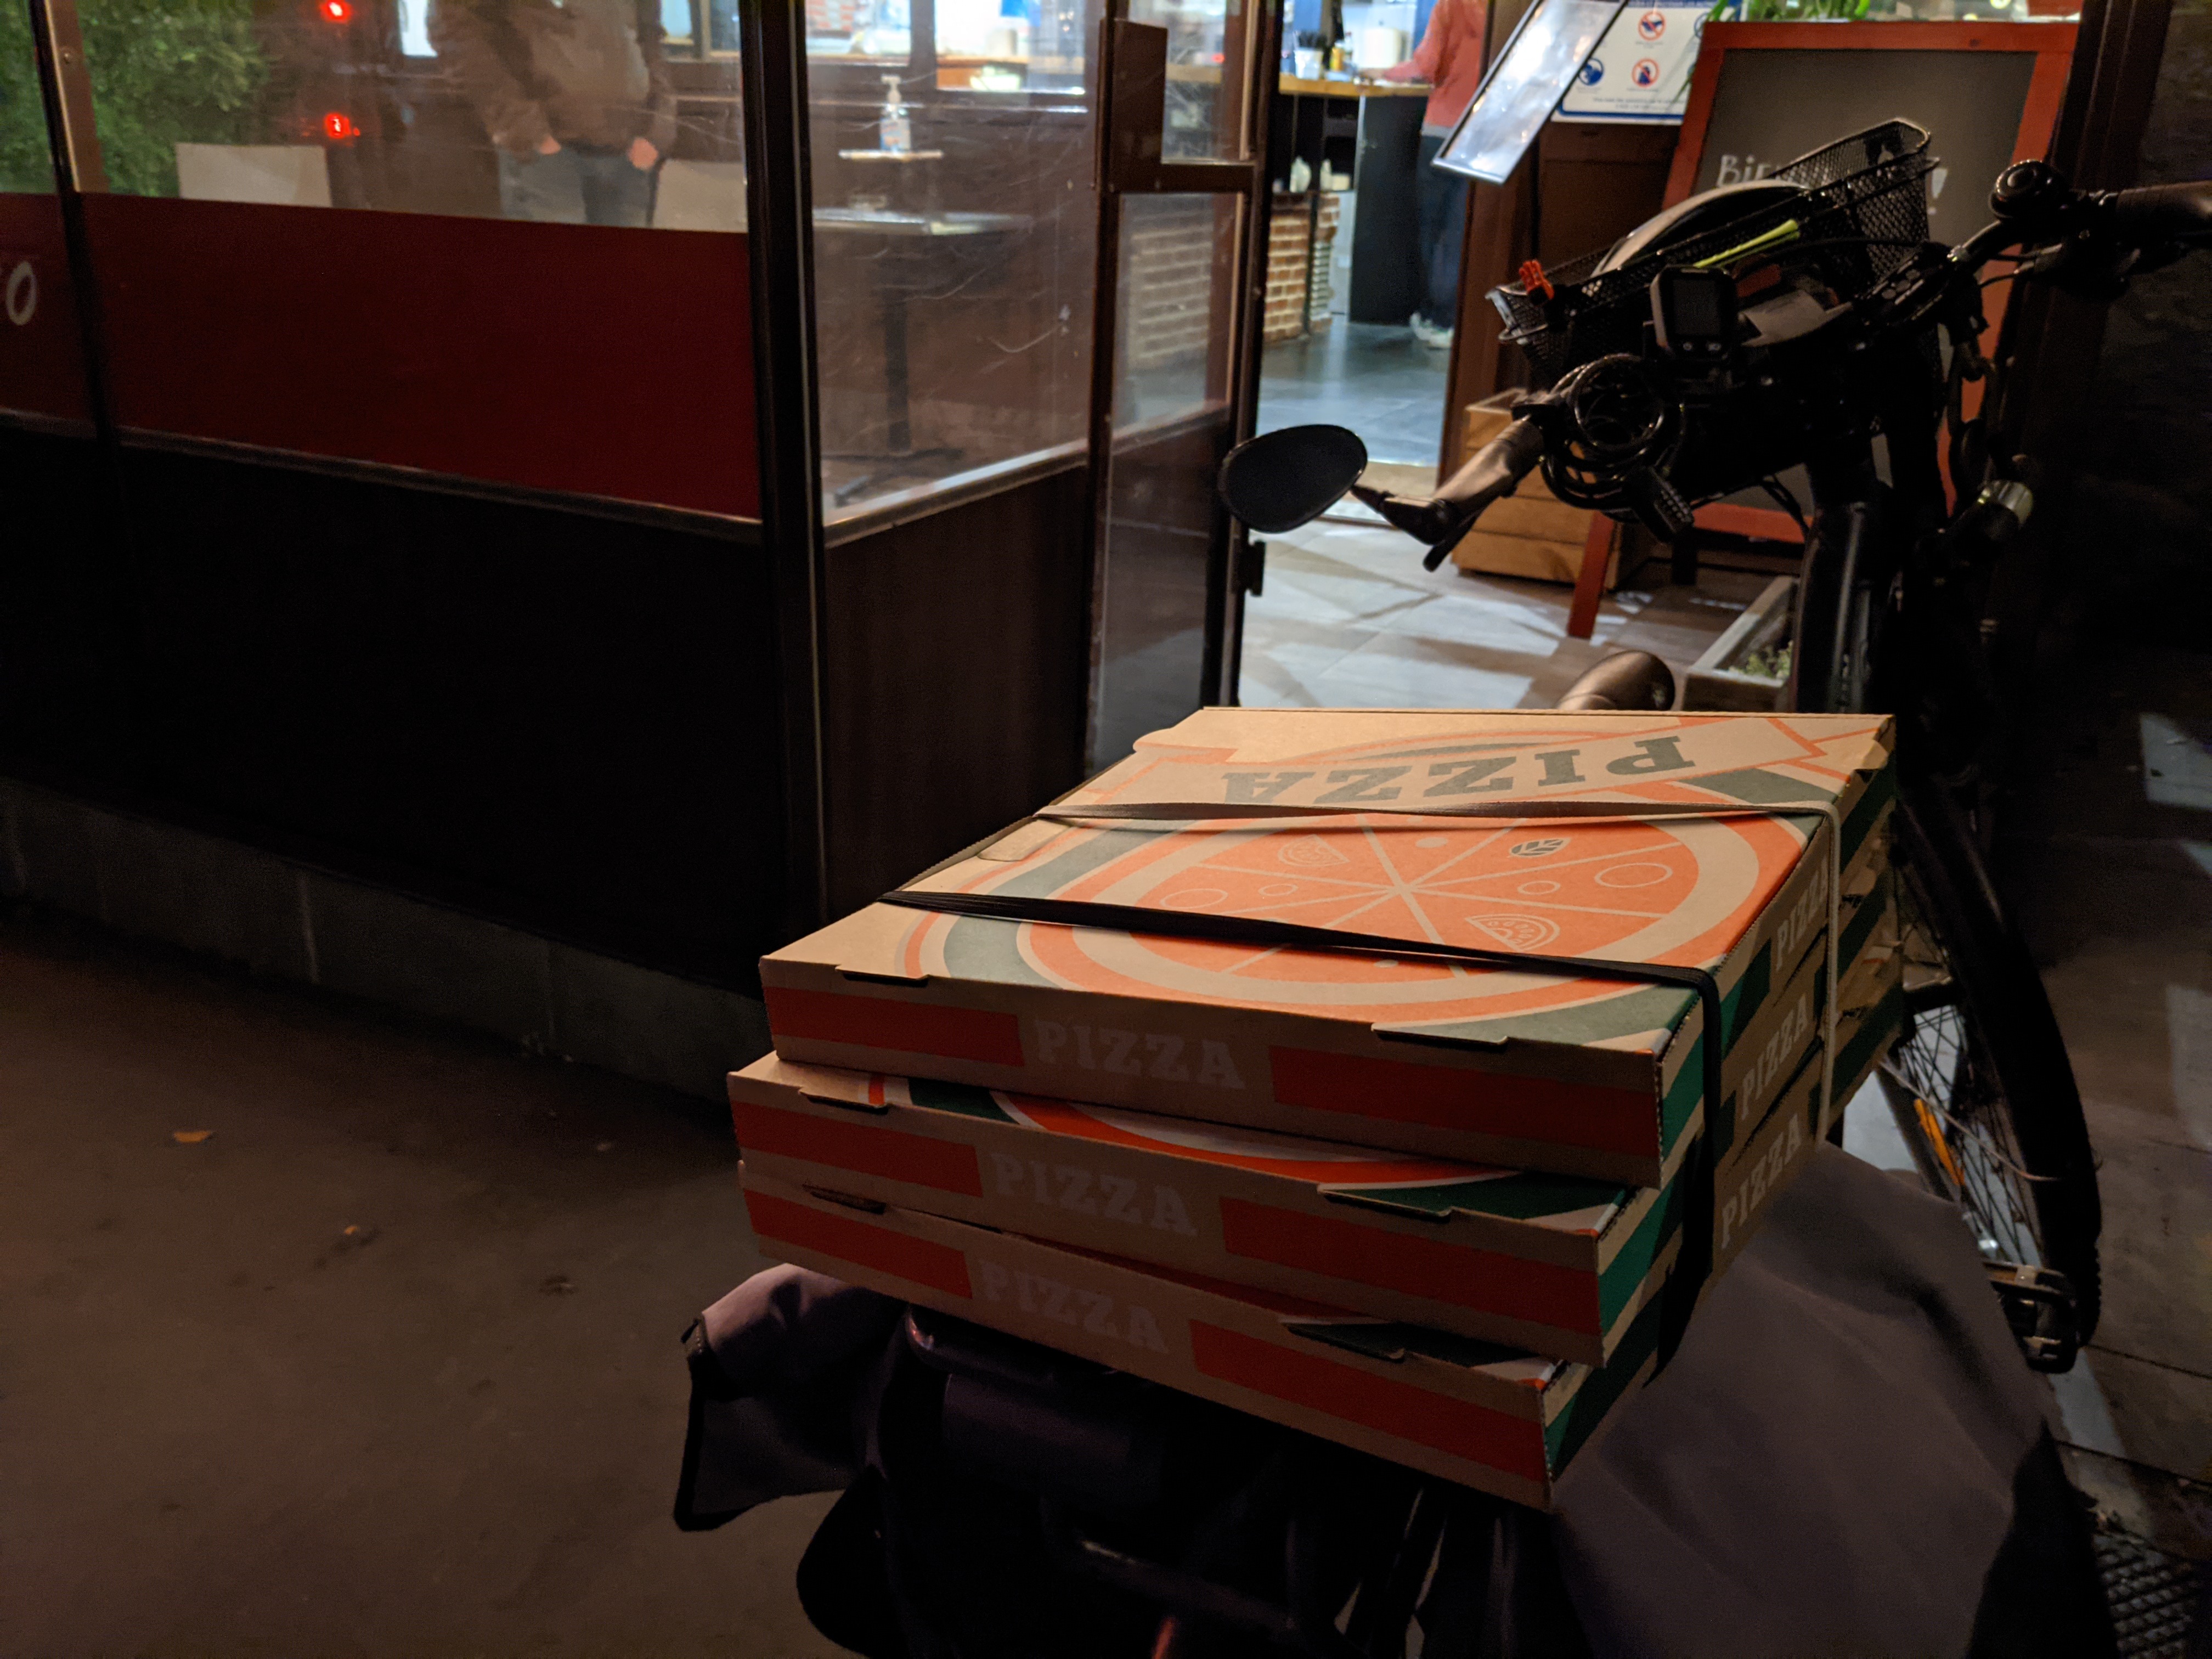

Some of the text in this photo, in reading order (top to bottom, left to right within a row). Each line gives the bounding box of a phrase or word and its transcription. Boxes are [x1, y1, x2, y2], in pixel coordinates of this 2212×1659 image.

[1222, 736, 1696, 804] PIZZA
[1033, 1018, 1246, 1090] PIZZA
[1741, 992, 1809, 1120] PIZZA
[990, 1152, 1198, 1237] PIZZA
[1721, 1112, 1802, 1249] PIZZA
[979, 1260, 1170, 1353] PIZZA
